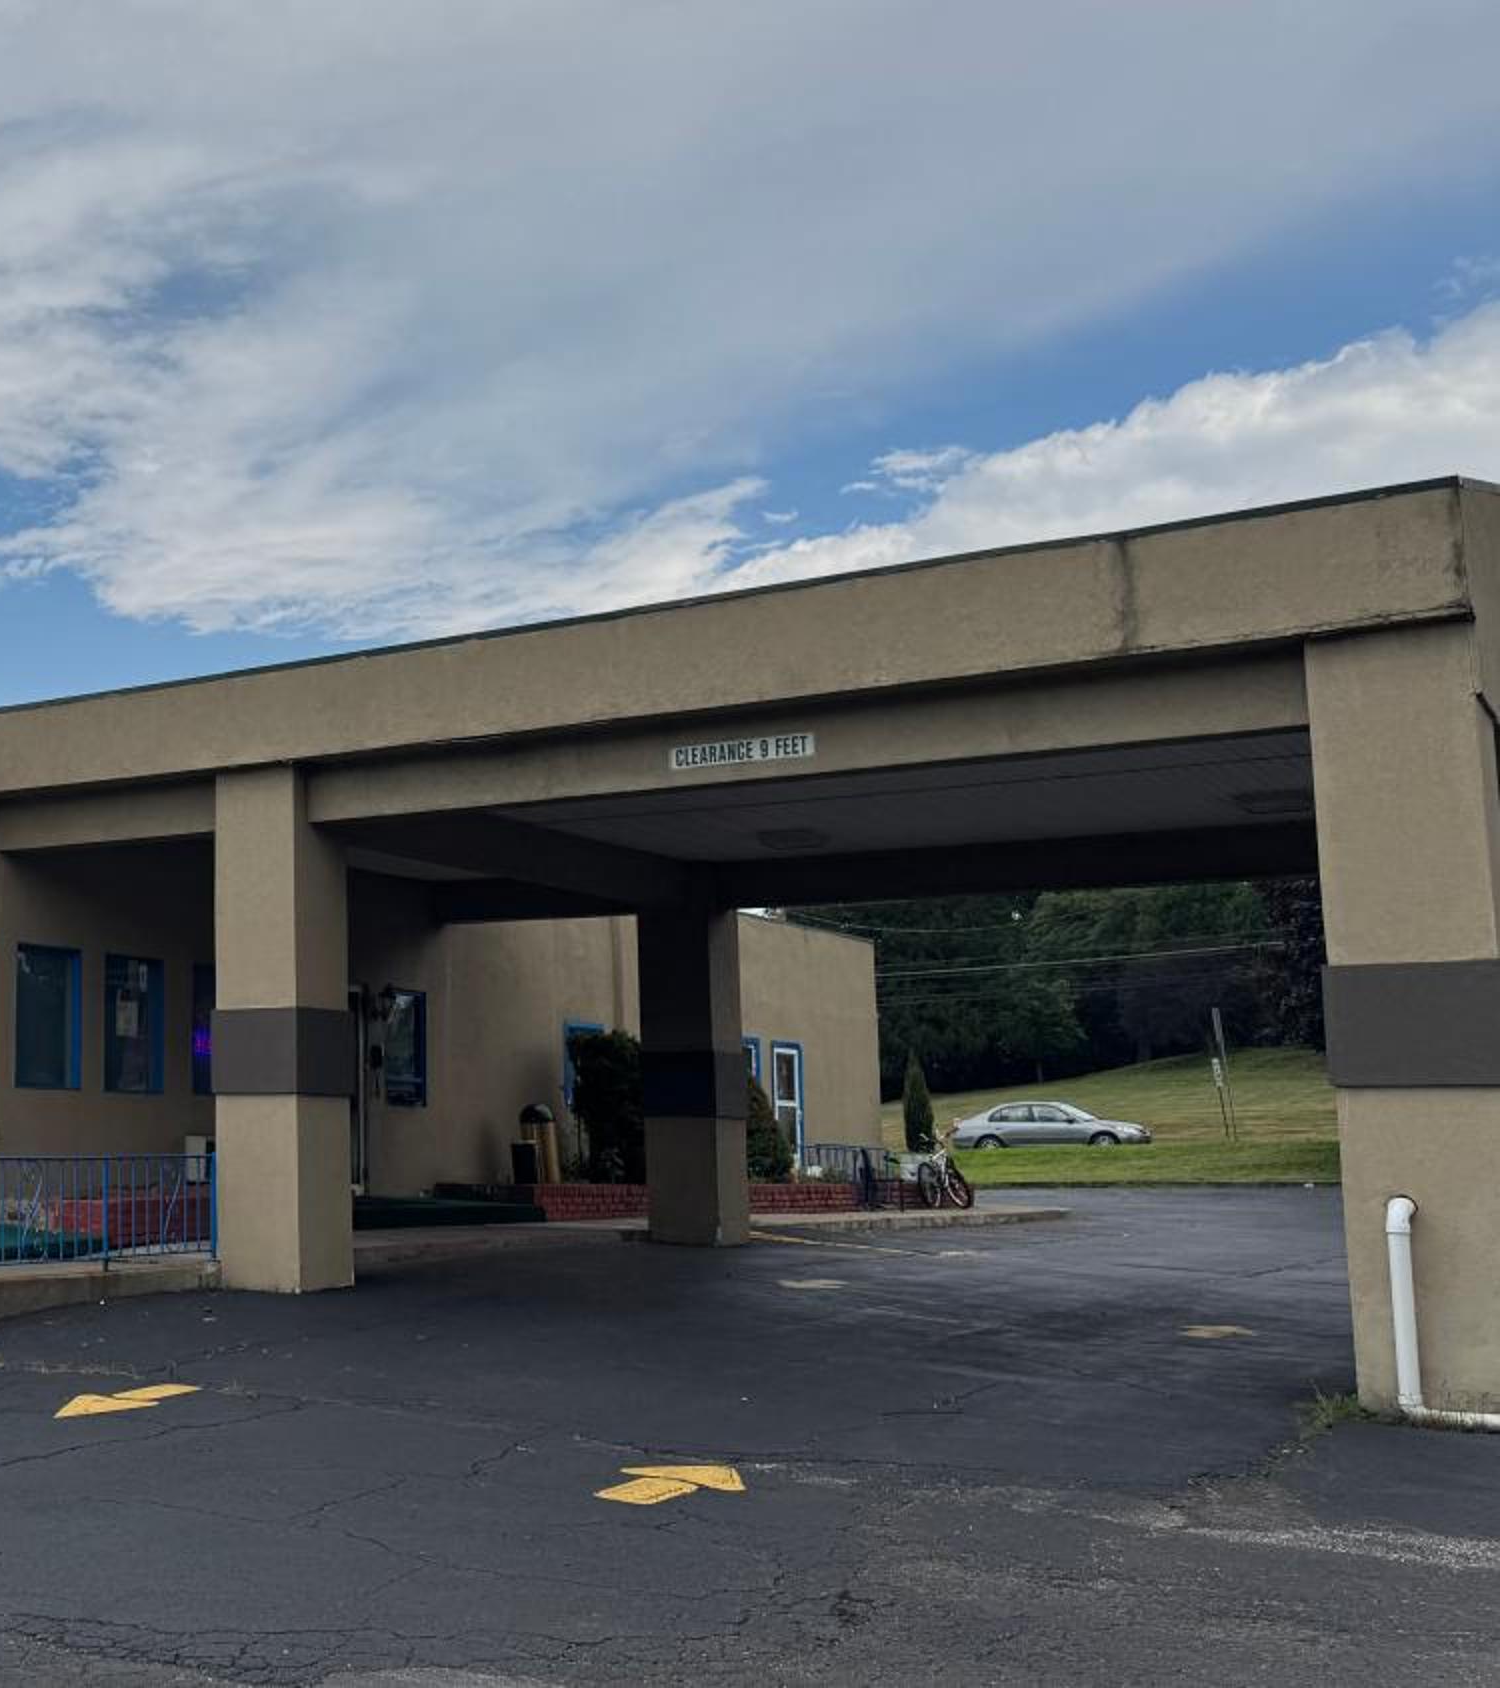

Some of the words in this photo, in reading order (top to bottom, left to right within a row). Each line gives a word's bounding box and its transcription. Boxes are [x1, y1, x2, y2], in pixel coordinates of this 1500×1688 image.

[675, 740, 753, 767] CLEARANCE
[759, 739, 769, 758] 9
[775, 735, 808, 757] FEET
